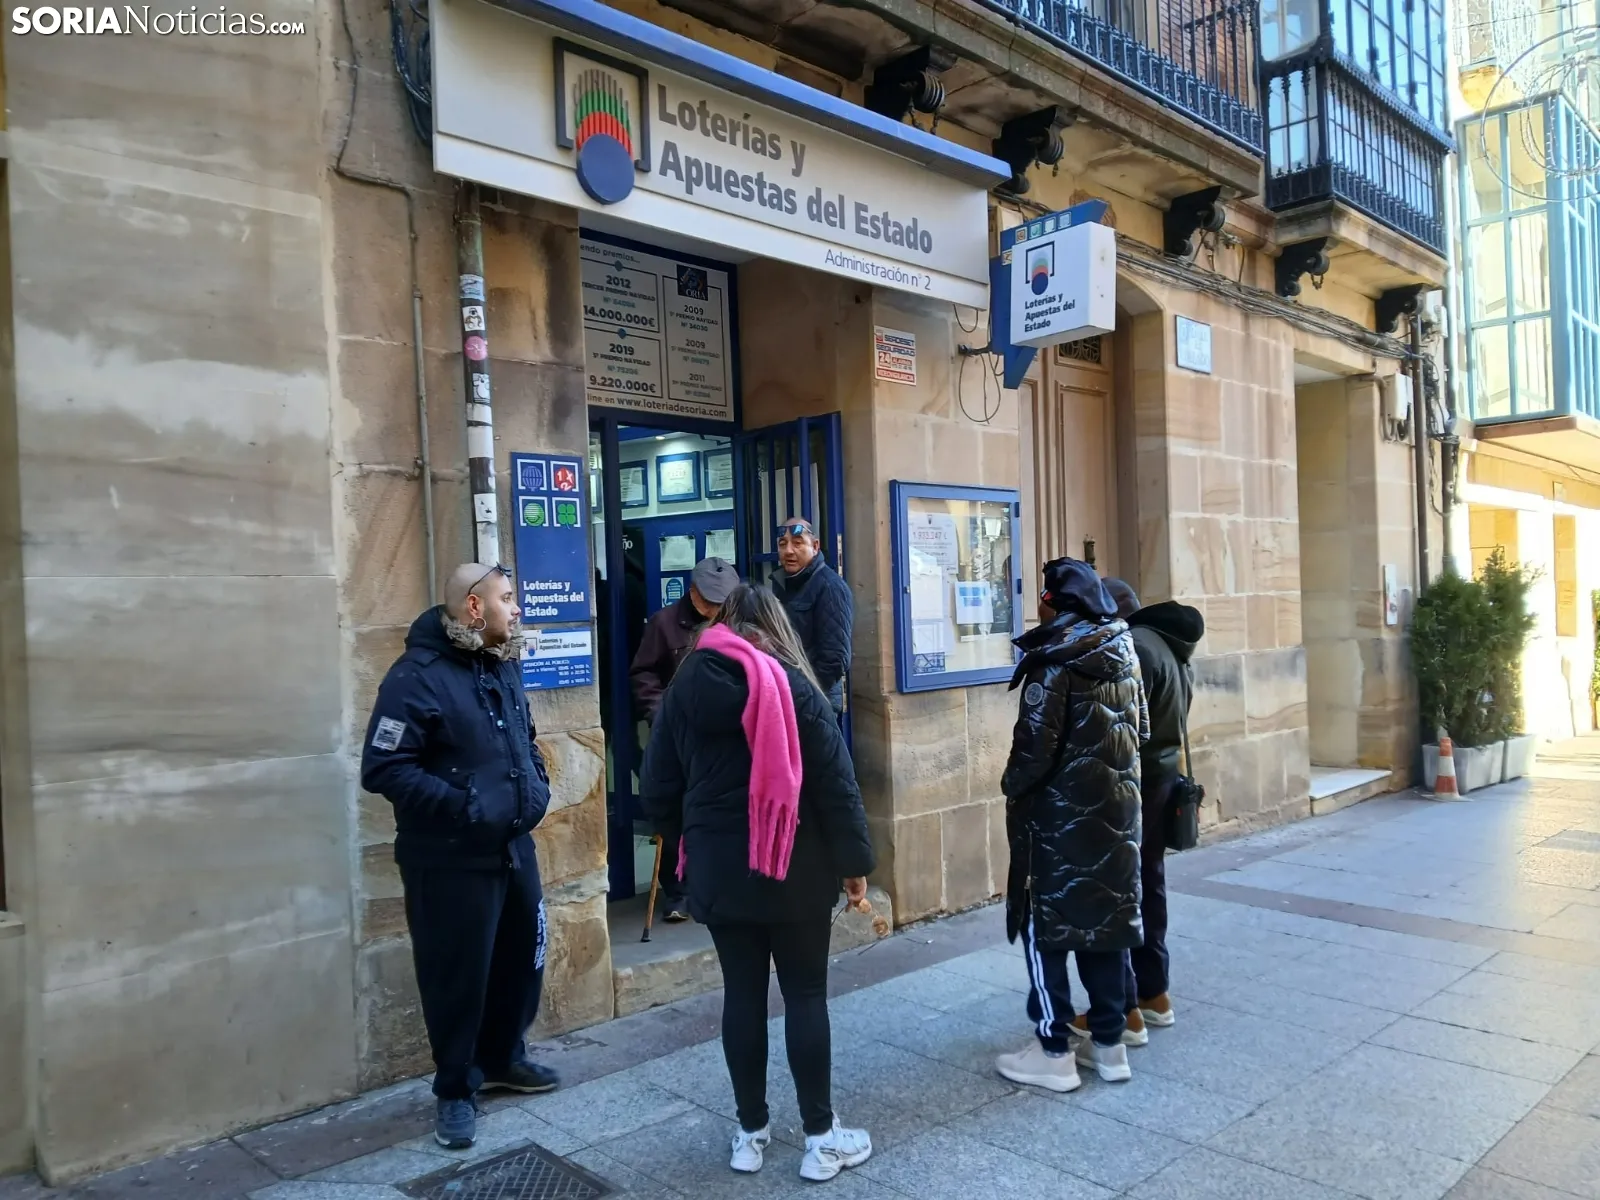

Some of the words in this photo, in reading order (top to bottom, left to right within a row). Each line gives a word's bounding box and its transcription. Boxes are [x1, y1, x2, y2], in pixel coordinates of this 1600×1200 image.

[658, 84, 781, 160] Loterías
[790, 139, 806, 177] y
[659, 140, 797, 215] Apuestas
[807, 187, 845, 230] del
[854, 201, 932, 254] Estado
[824, 249, 909, 286] Administración
[924, 275, 931, 290] 2
[606, 275, 631, 289] 2012
[605, 286, 628, 297] PREMIO
[629, 291, 656, 302] NAVIDAD
[1025, 294, 1056, 310] Loterías
[1058, 293, 1063, 302] y
[684, 305, 704, 316] 2009
[1025, 306, 1061, 321] Apuestas
[1062, 299, 1076, 312] del
[675, 313, 696, 321] PREMIO
[696, 316, 719, 326] NAVIDAD
[1024, 319, 1051, 332] Estado
[609, 343, 635, 356] 2019
[685, 339, 706, 349] 2009
[876, 344, 915, 357] SEGURIDAD
[600, 353, 623, 362] PREMIO
[624, 357, 652, 367] NAVIDAD
[879, 352, 891, 364] 24
[589, 375, 656, 393] 9.220.000€
[689, 373, 706, 383] 2011
[605, 396, 615, 404] en
[616, 396, 727, 418] www.loteriadesoria.com
[523, 580, 562, 591] Loterías
[564, 581, 570, 592] y
[525, 593, 569, 605] Apuestas
[569, 592, 584, 602] del
[525, 606, 558, 617] Estado
